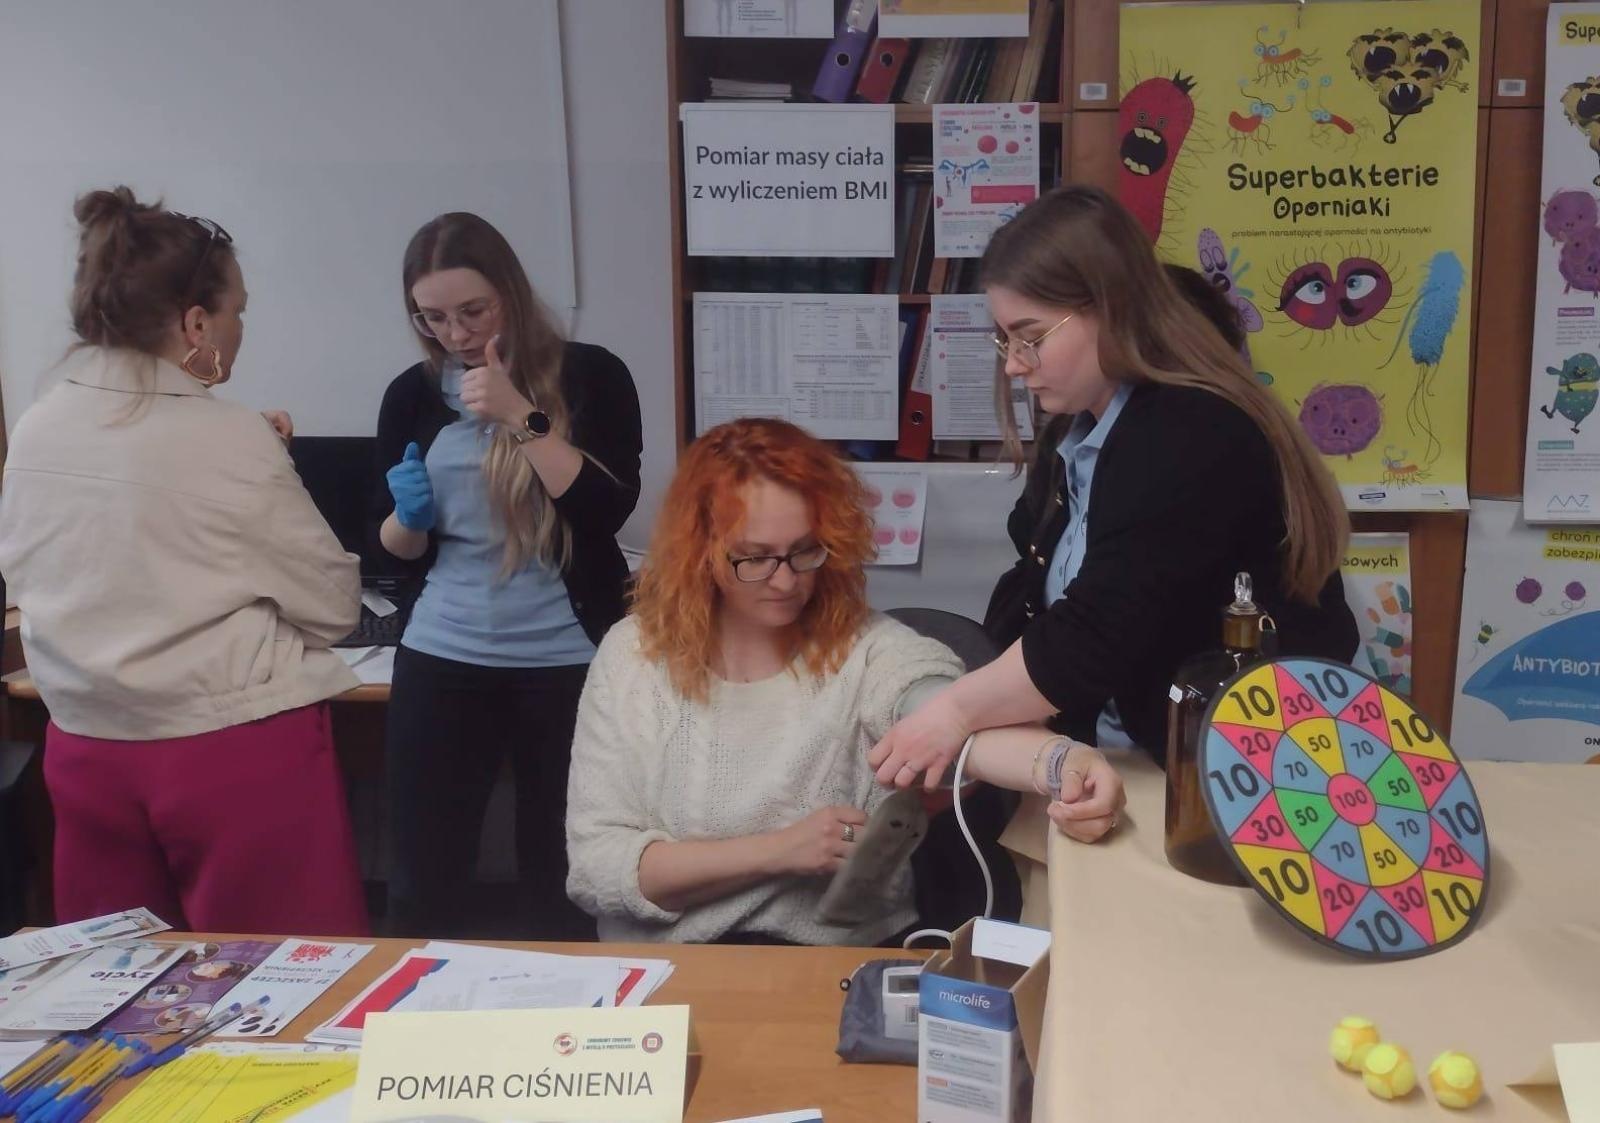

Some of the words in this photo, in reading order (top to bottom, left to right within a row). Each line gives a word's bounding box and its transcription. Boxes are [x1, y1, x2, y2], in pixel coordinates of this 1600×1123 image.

[696, 145, 770, 165] Pomiar
[775, 149, 828, 171] masy
[835, 145, 885, 165] ciała
[1228, 162, 1439, 194] Superbakterie
[693, 184, 703, 199] z
[708, 180, 837, 207] wyliczeniem
[844, 181, 888, 200] BMI
[1273, 196, 1391, 223] Oporniaki
[1231, 229, 1266, 239] problem
[1269, 229, 1322, 239] narastającej
[1383, 226, 1432, 237] antybiotyki
[1305, 669, 1349, 702] 10
[1230, 685, 1274, 720] 10
[1284, 693, 1313, 716] 30
[1353, 702, 1381, 724] 20
[1308, 734, 1331, 752] 50
[1392, 714, 1434, 748] 10
[1241, 732, 1271, 756] 20
[1351, 740, 1374, 758] 70
[1209, 763, 1260, 801] 10
[1284, 761, 1308, 780] 70
[1416, 762, 1445, 786] 30
[1337, 790, 1368, 809] 100
[1388, 779, 1410, 797] 50
[1251, 815, 1284, 841] 30
[1295, 806, 1319, 826] 50
[1396, 819, 1420, 838] 70
[1440, 802, 1480, 839] 10
[1331, 841, 1355, 861] 70
[1375, 849, 1397, 868] 50
[1434, 843, 1464, 868] 20
[1260, 859, 1310, 902] 10
[1323, 883, 1355, 911] 20
[1393, 886, 1424, 912] 30
[1432, 882, 1475, 921] 10
[1356, 911, 1403, 952] 10
[938, 990, 990, 1009] microlife
[377, 1074, 495, 1102] POMIAR
[502, 1067, 653, 1099] CIŚNIENIA
